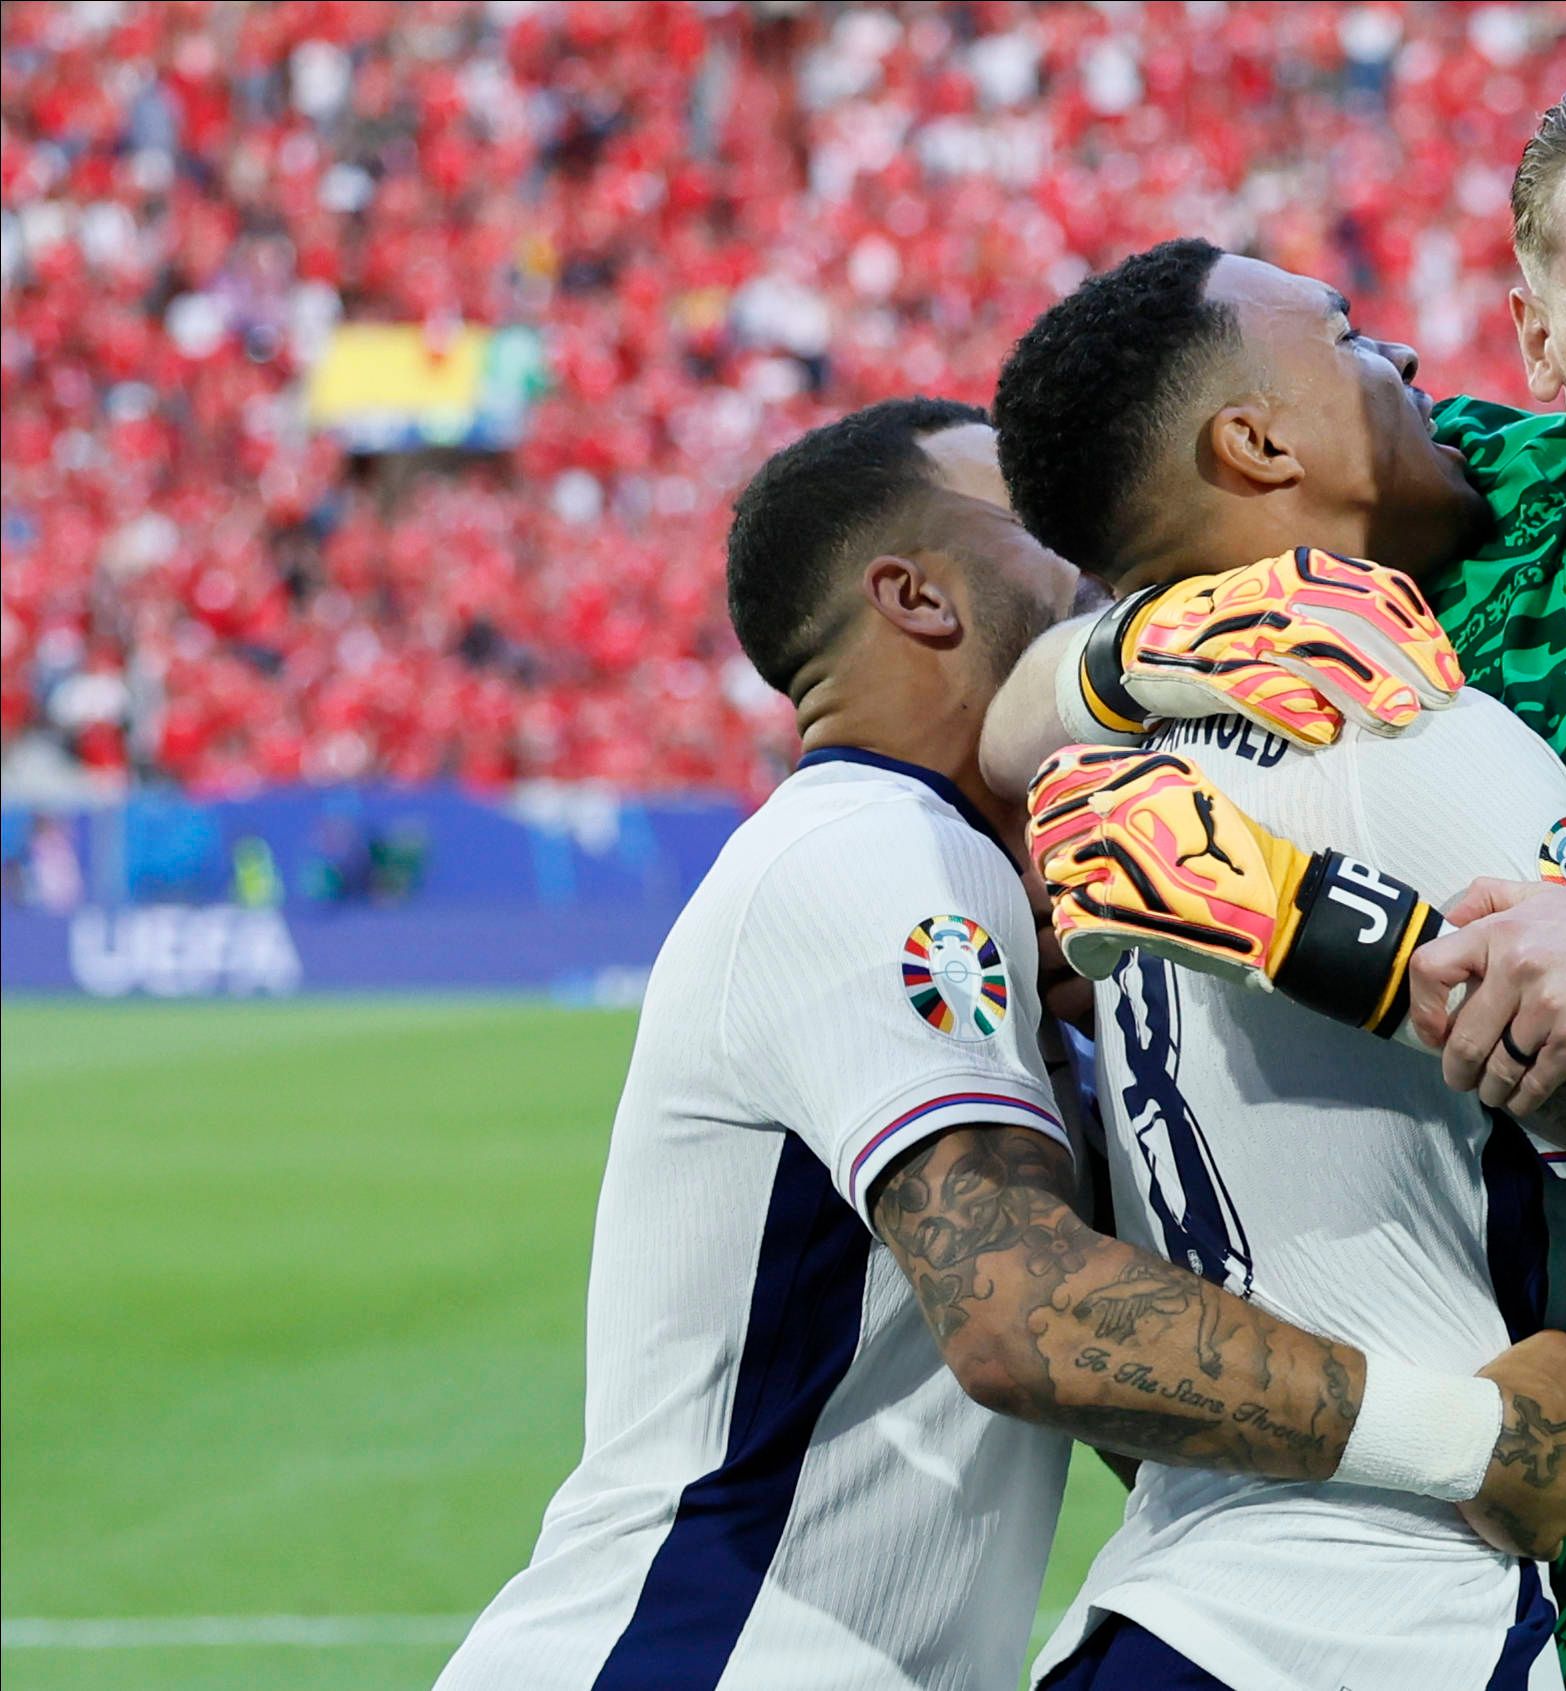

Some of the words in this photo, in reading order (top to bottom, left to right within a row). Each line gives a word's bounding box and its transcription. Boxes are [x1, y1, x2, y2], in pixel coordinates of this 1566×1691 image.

[1327, 856, 1401, 944] JP
[69, 903, 303, 997] UEFA
[1075, 1347, 1111, 1372] To
[1114, 1363, 1158, 1394] The
[1161, 1378, 1226, 1414] Stars
